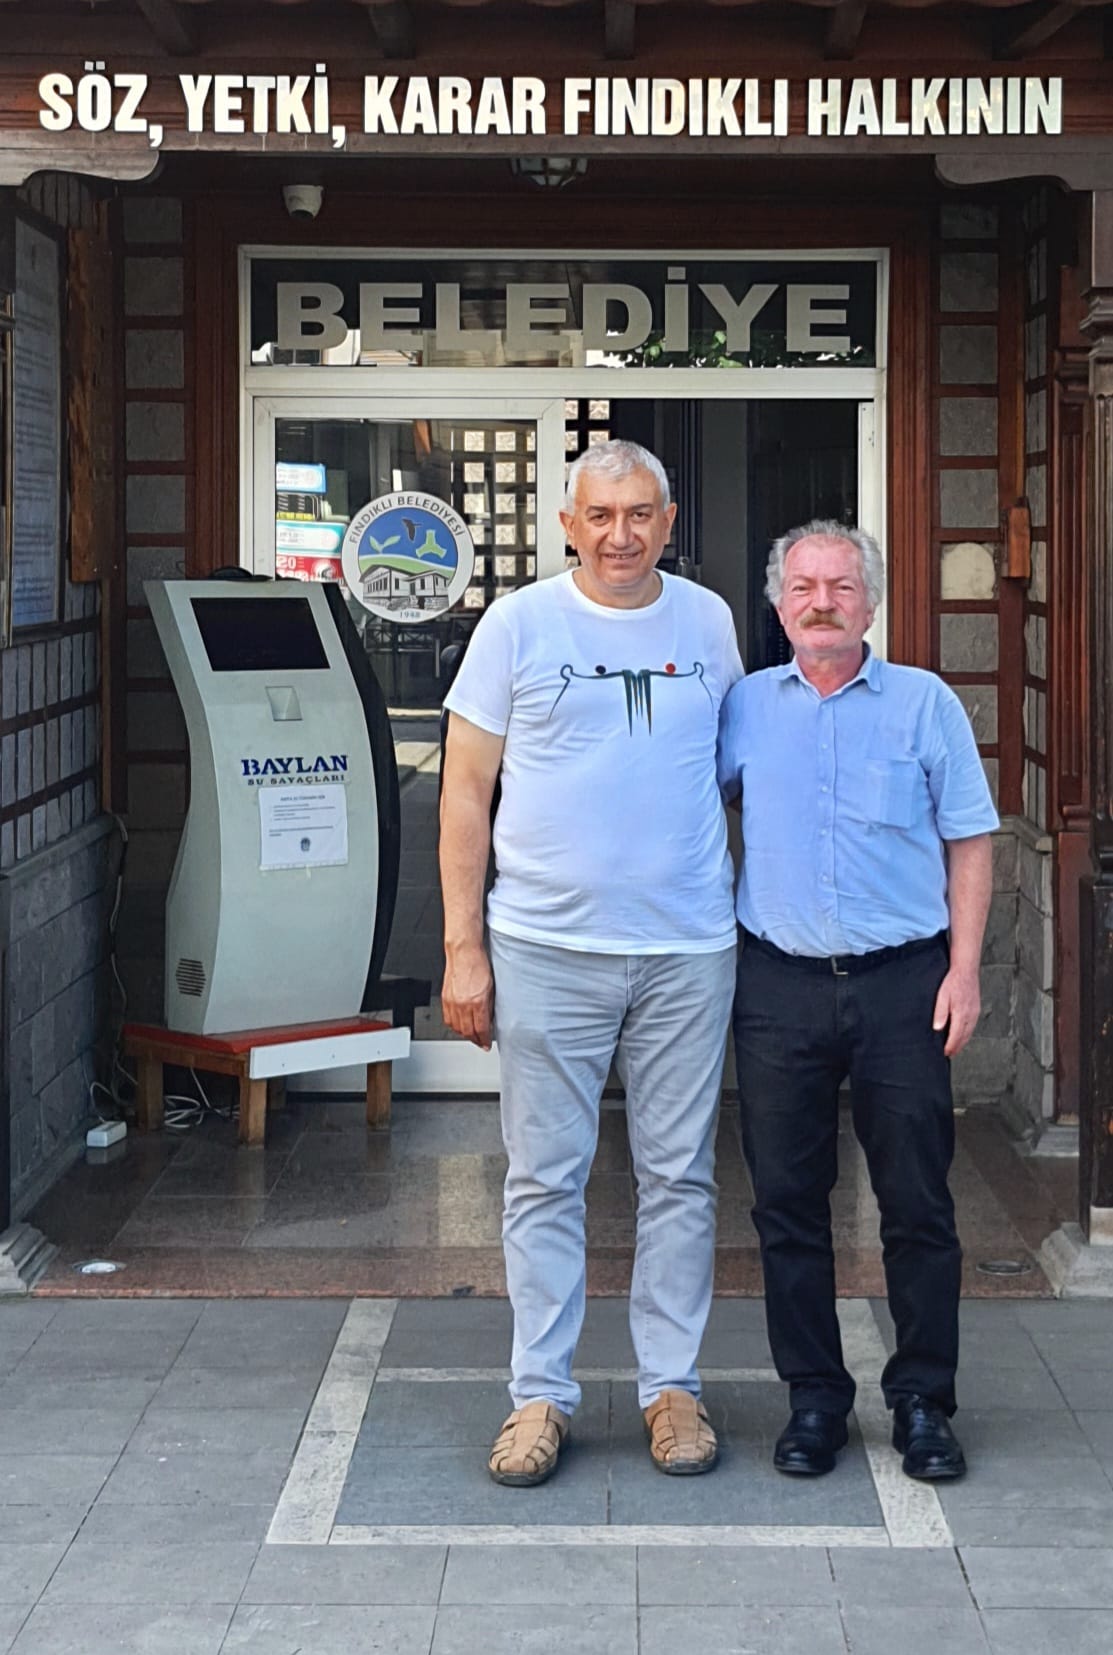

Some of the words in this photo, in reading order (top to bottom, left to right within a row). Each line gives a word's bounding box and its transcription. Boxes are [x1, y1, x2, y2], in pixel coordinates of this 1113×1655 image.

[38, 61, 164, 148] SÖZ,
[178, 63, 347, 148] YETKİ,
[363, 76, 546, 136] KARAR
[563, 77, 788, 136] FINDIKLI
[807, 77, 1063, 136] HALKININ
[276, 267, 851, 353] BELEDİYE
[350, 500, 393, 544] FINDIKLI
[398, 497, 465, 537] BELEDİYESİ
[242, 754, 348, 776] BAYLAN
[270, 774, 346, 786] SAYAÇLARI
